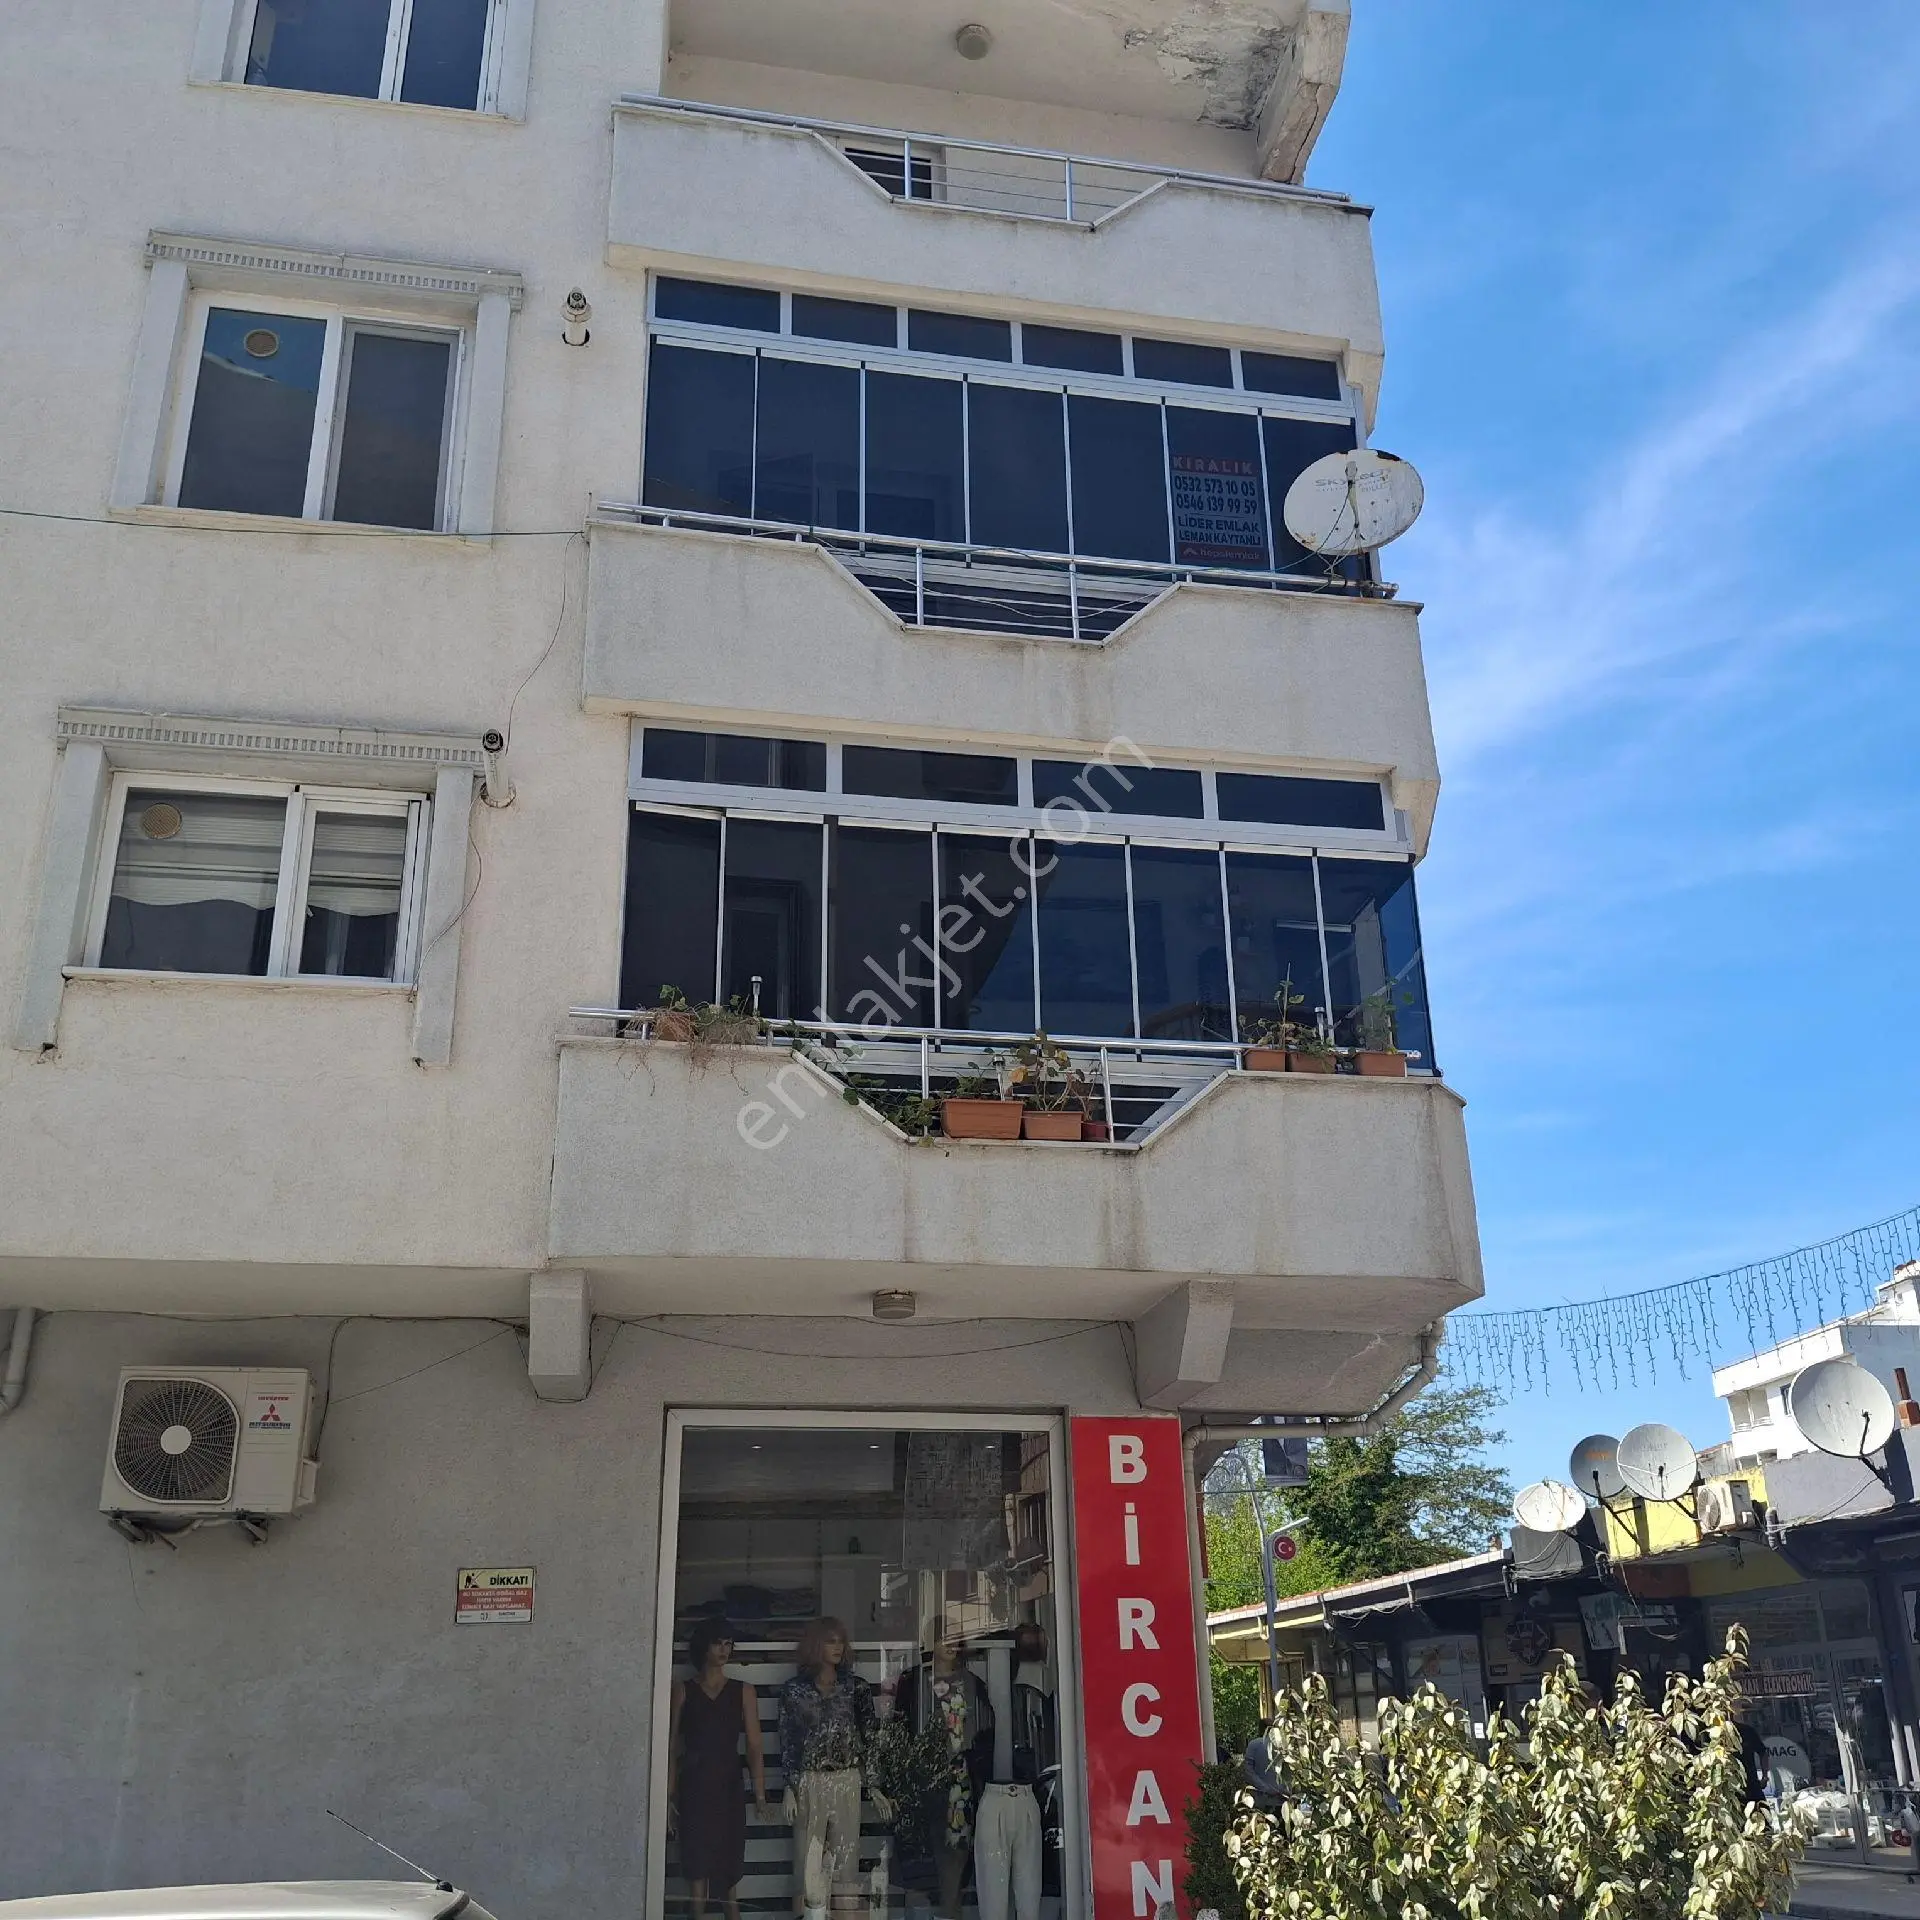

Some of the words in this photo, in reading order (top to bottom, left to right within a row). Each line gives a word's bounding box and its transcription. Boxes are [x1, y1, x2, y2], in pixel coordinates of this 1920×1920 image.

[1173, 456, 1253, 474] KIRALIK
[1174, 475, 1200, 492] 0532
[1204, 478, 1224, 494] 573
[1226, 480, 1238, 495] 10
[1241, 481, 1256, 497] 05
[1176, 493, 1204, 511] 0546
[1207, 496, 1224, 512] 139
[1228, 498, 1241, 514] 99
[1244, 499, 1258, 515] 59
[1178, 514, 1214, 530] LİDER
[1215, 519, 1260, 533] EMLAK
[1108, 1434, 1175, 1918] BİRCAN
